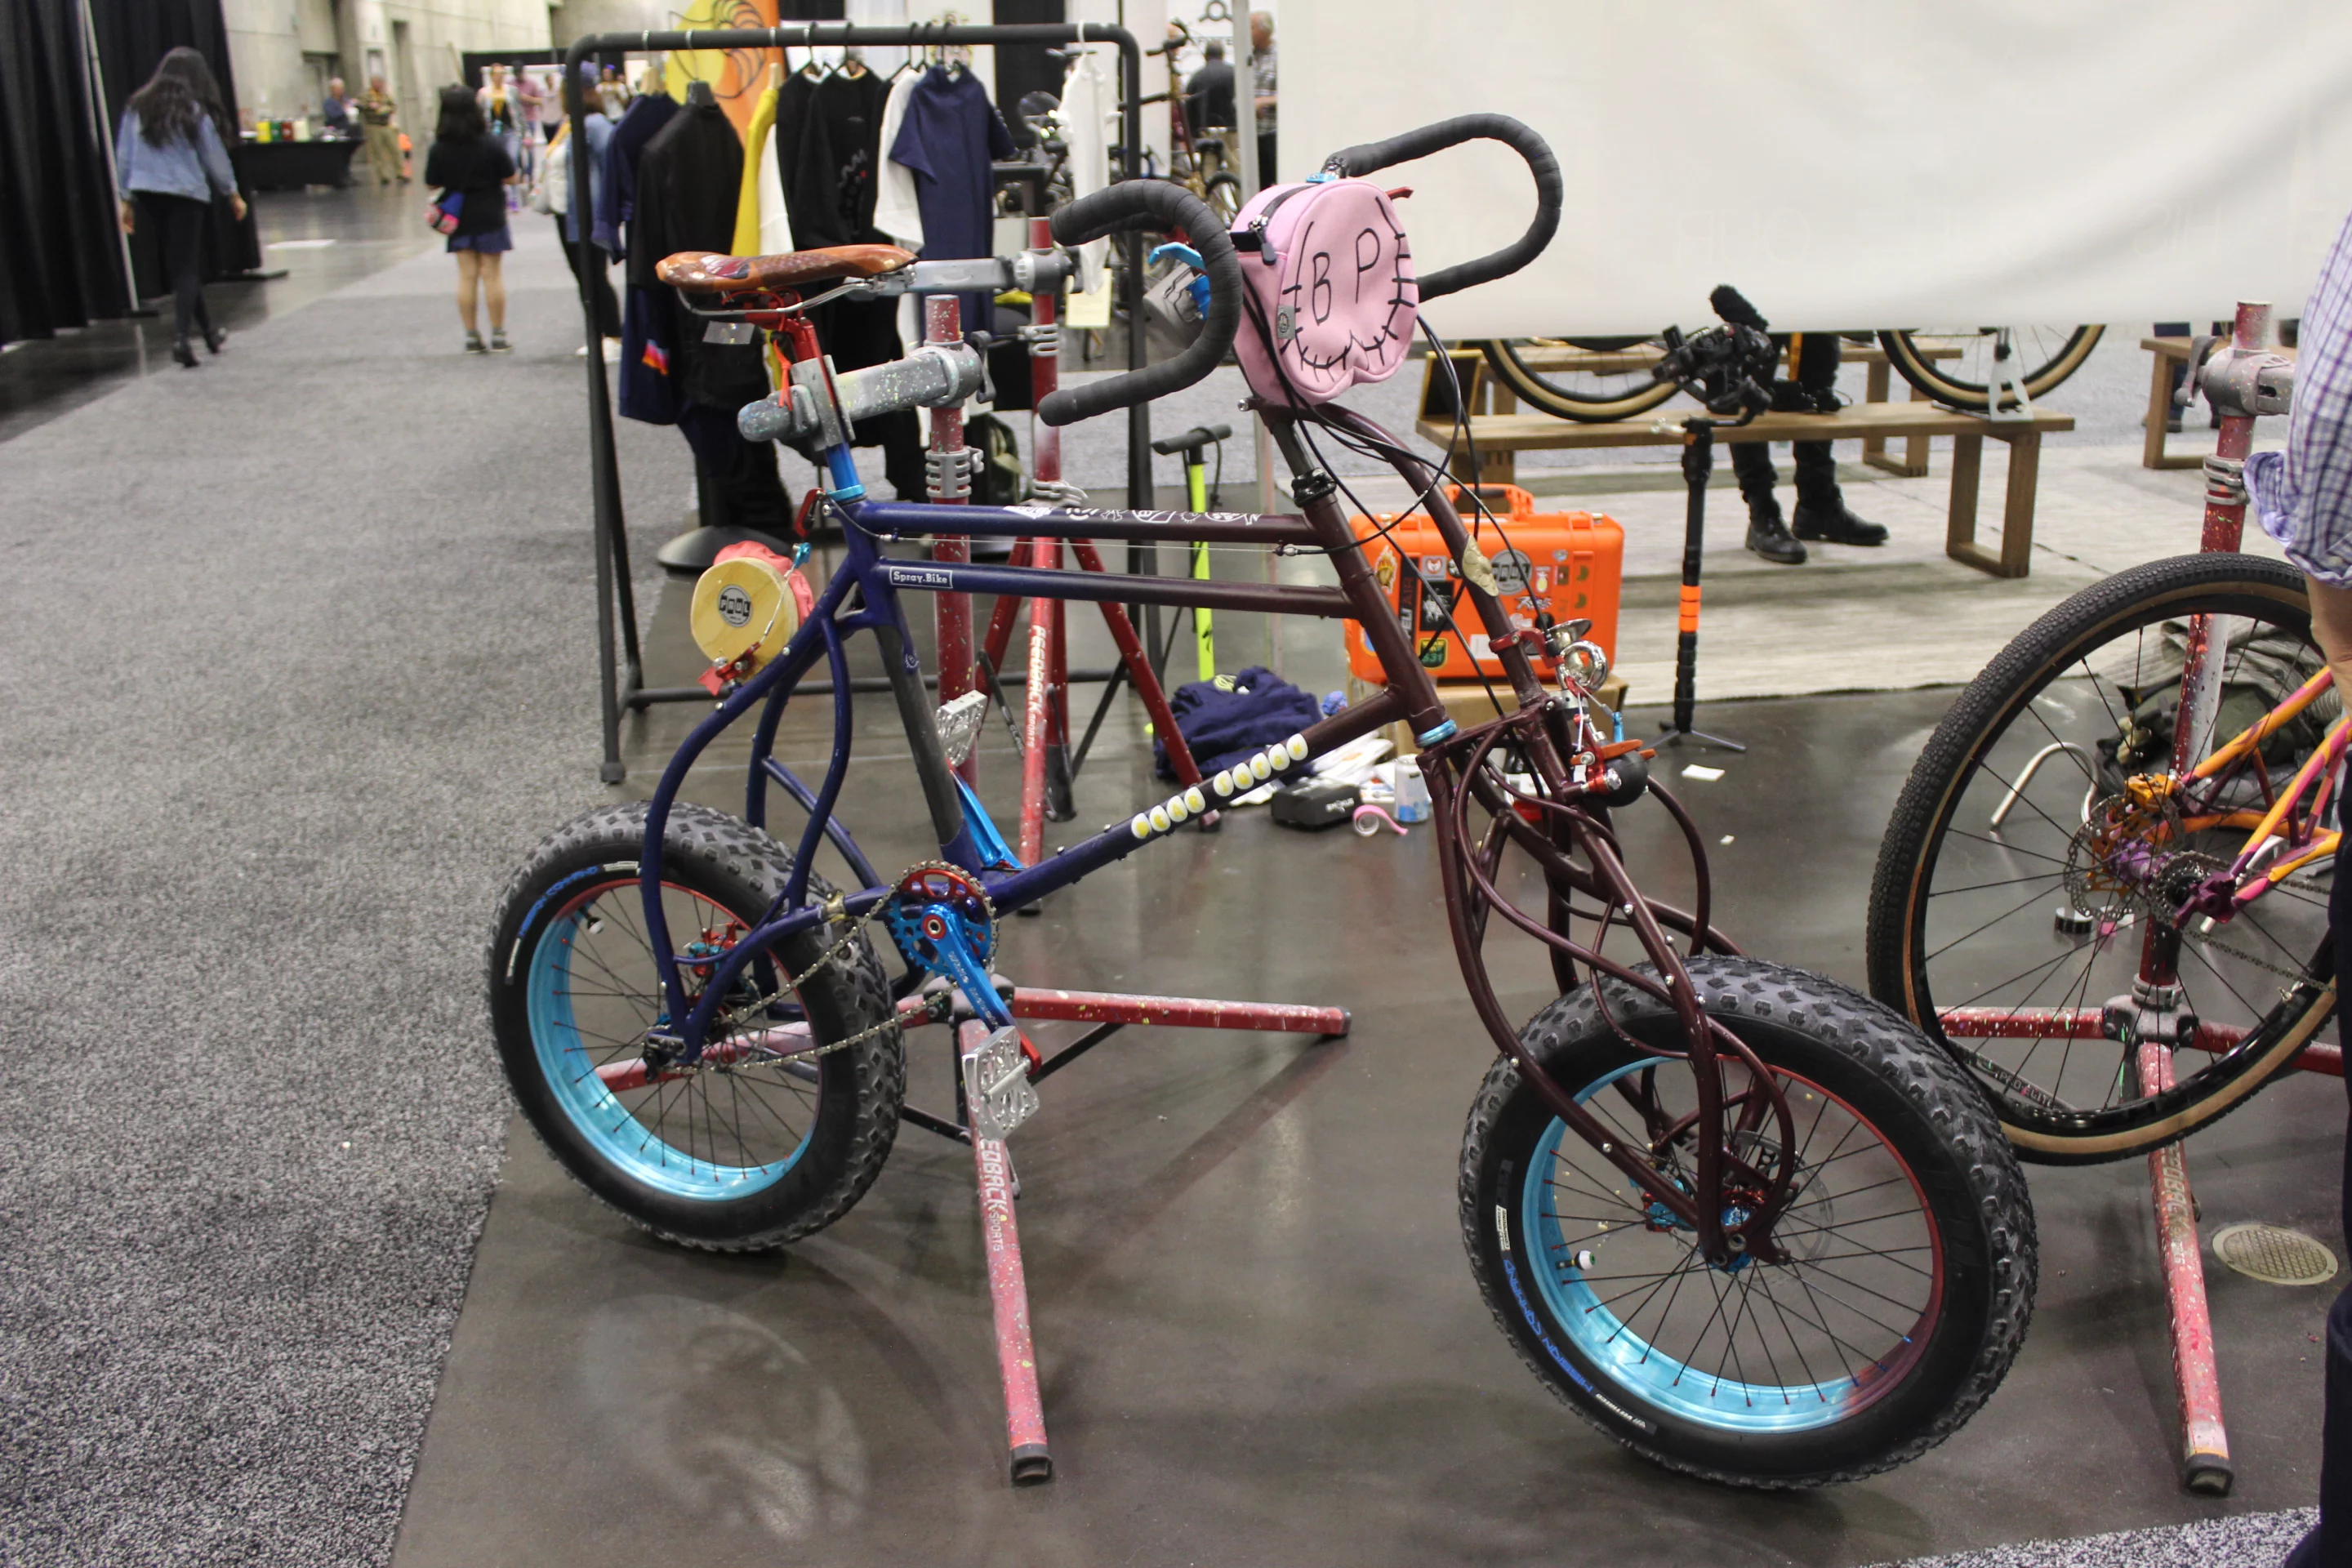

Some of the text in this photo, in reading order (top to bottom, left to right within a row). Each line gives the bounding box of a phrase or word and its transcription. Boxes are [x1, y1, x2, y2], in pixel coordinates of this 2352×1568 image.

[719, 595, 751, 617] PAUL
[893, 570, 948, 583] Spray.Bike
[1027, 625, 1047, 715] FEEDBACK
[979, 1137, 1009, 1252] EDBACK SPORTS
[2160, 1140, 2192, 1232] EEDBACK
[1503, 1258, 1544, 1336] COMMAND
[1541, 1337, 1594, 1393] MISSION
